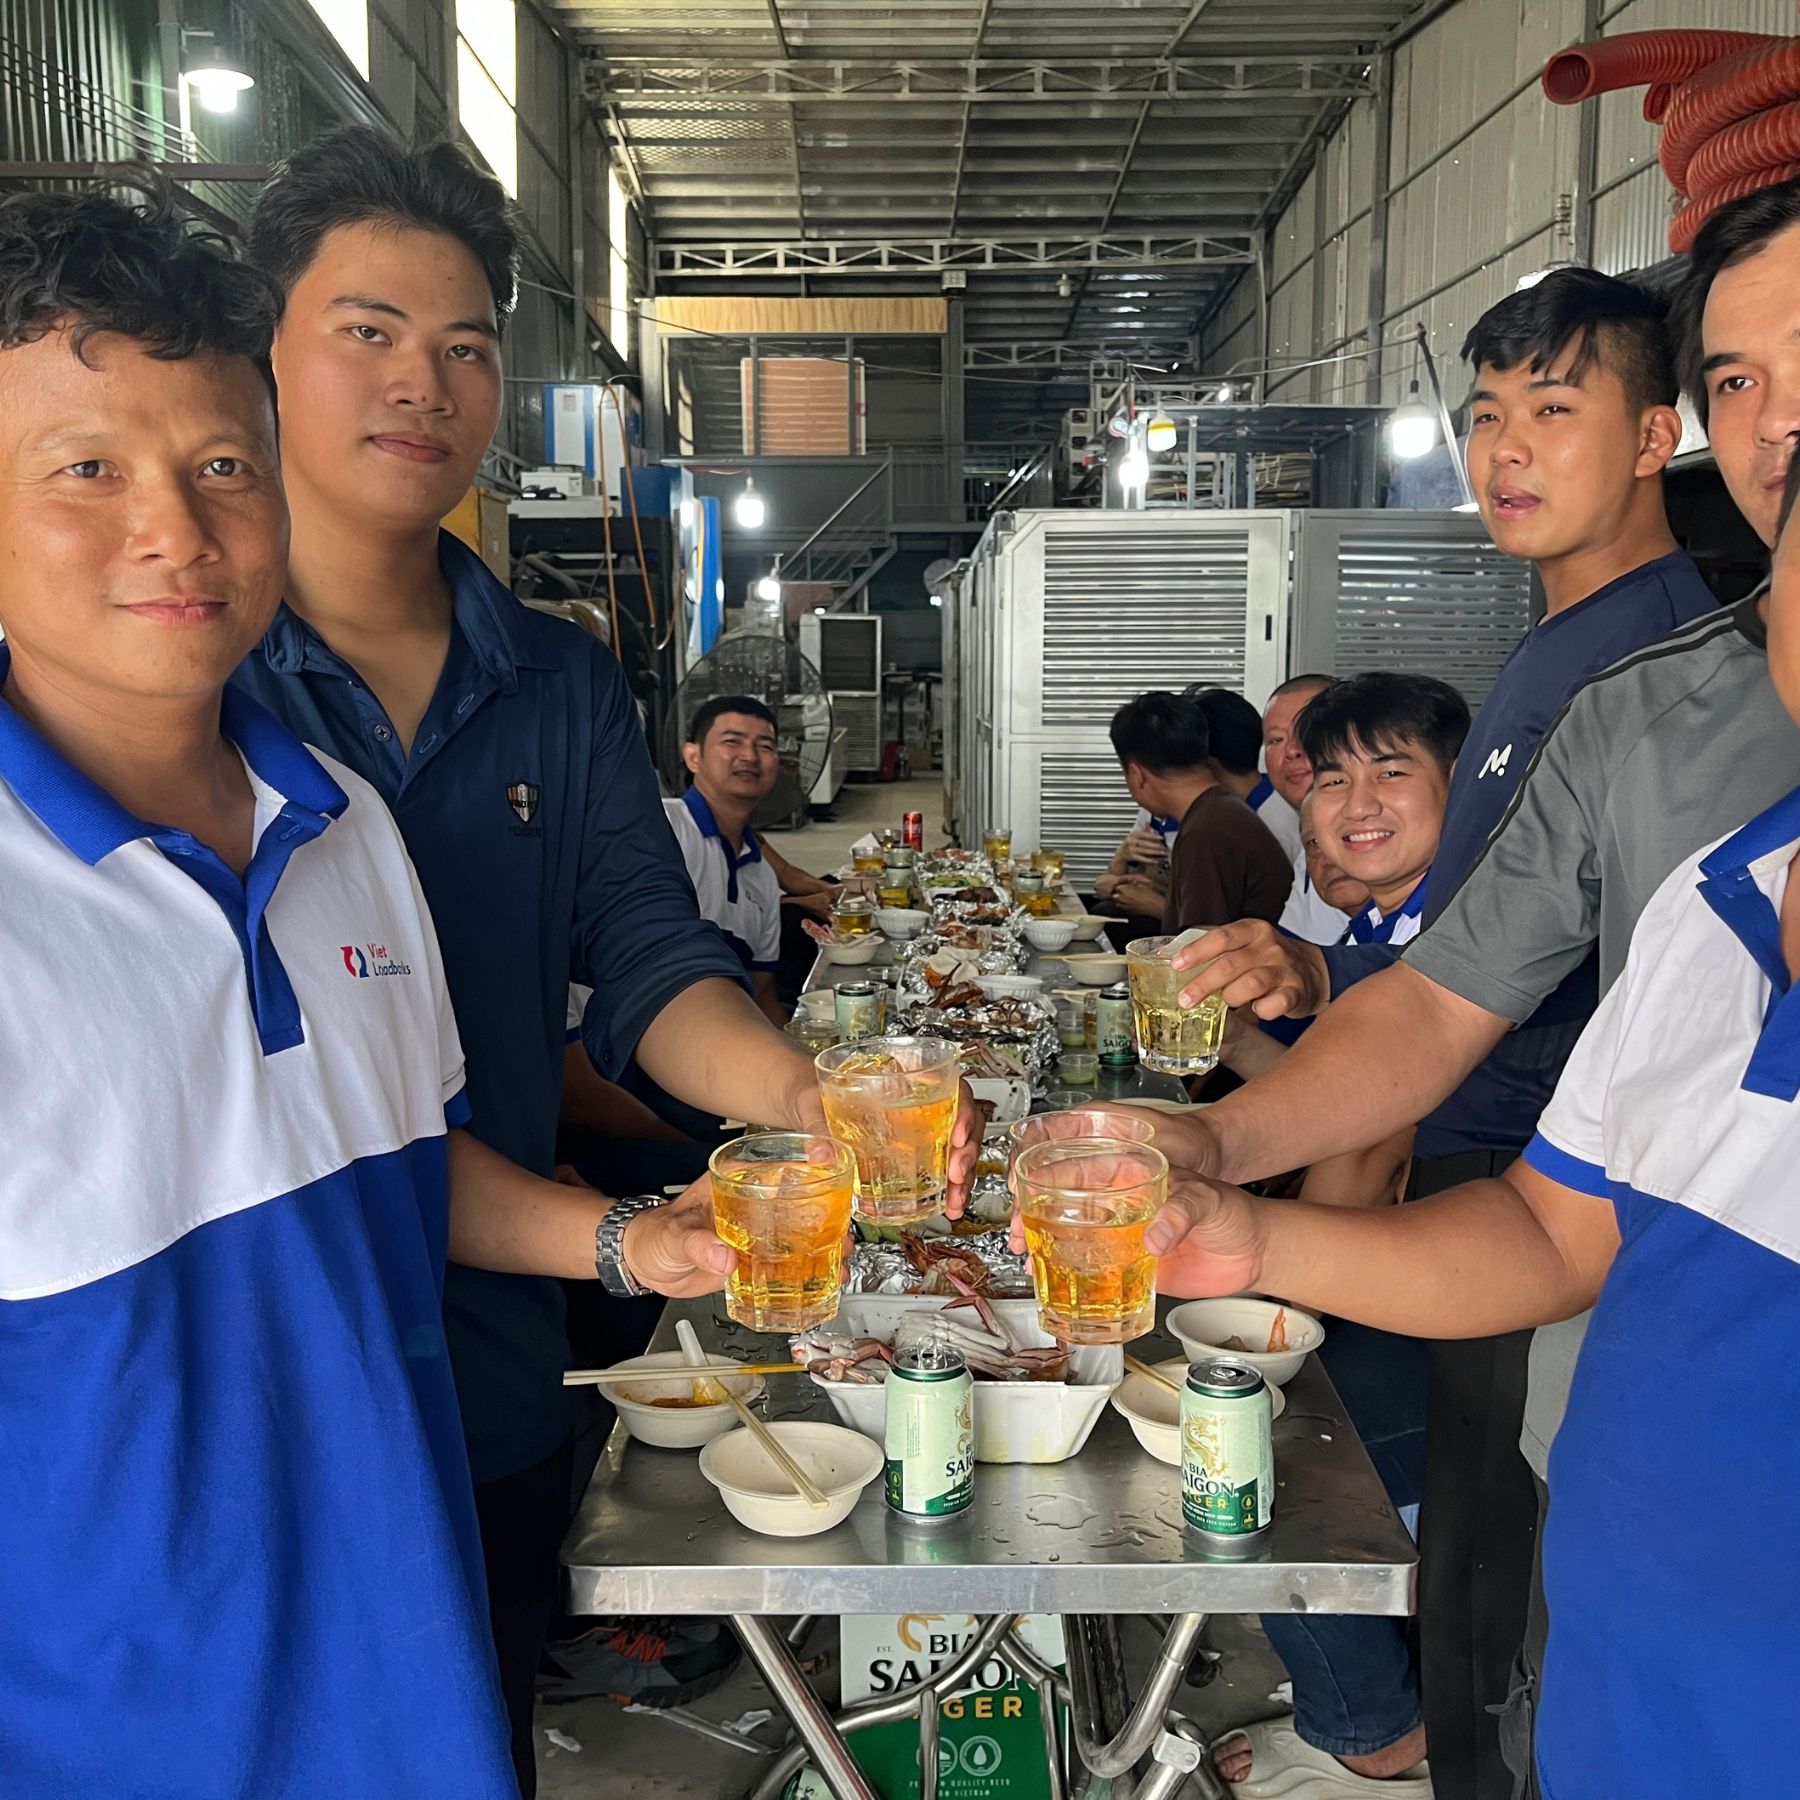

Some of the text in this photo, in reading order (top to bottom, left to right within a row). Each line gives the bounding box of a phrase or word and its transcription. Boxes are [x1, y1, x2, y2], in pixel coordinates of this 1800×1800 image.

[367, 943, 388, 958] Viet
[1103, 1039, 1132, 1048] SAIGO
[1189, 1463, 1208, 1478] BIA
[1182, 1469, 1235, 1497] AIGON
[1186, 1491, 1228, 1509] AGER
